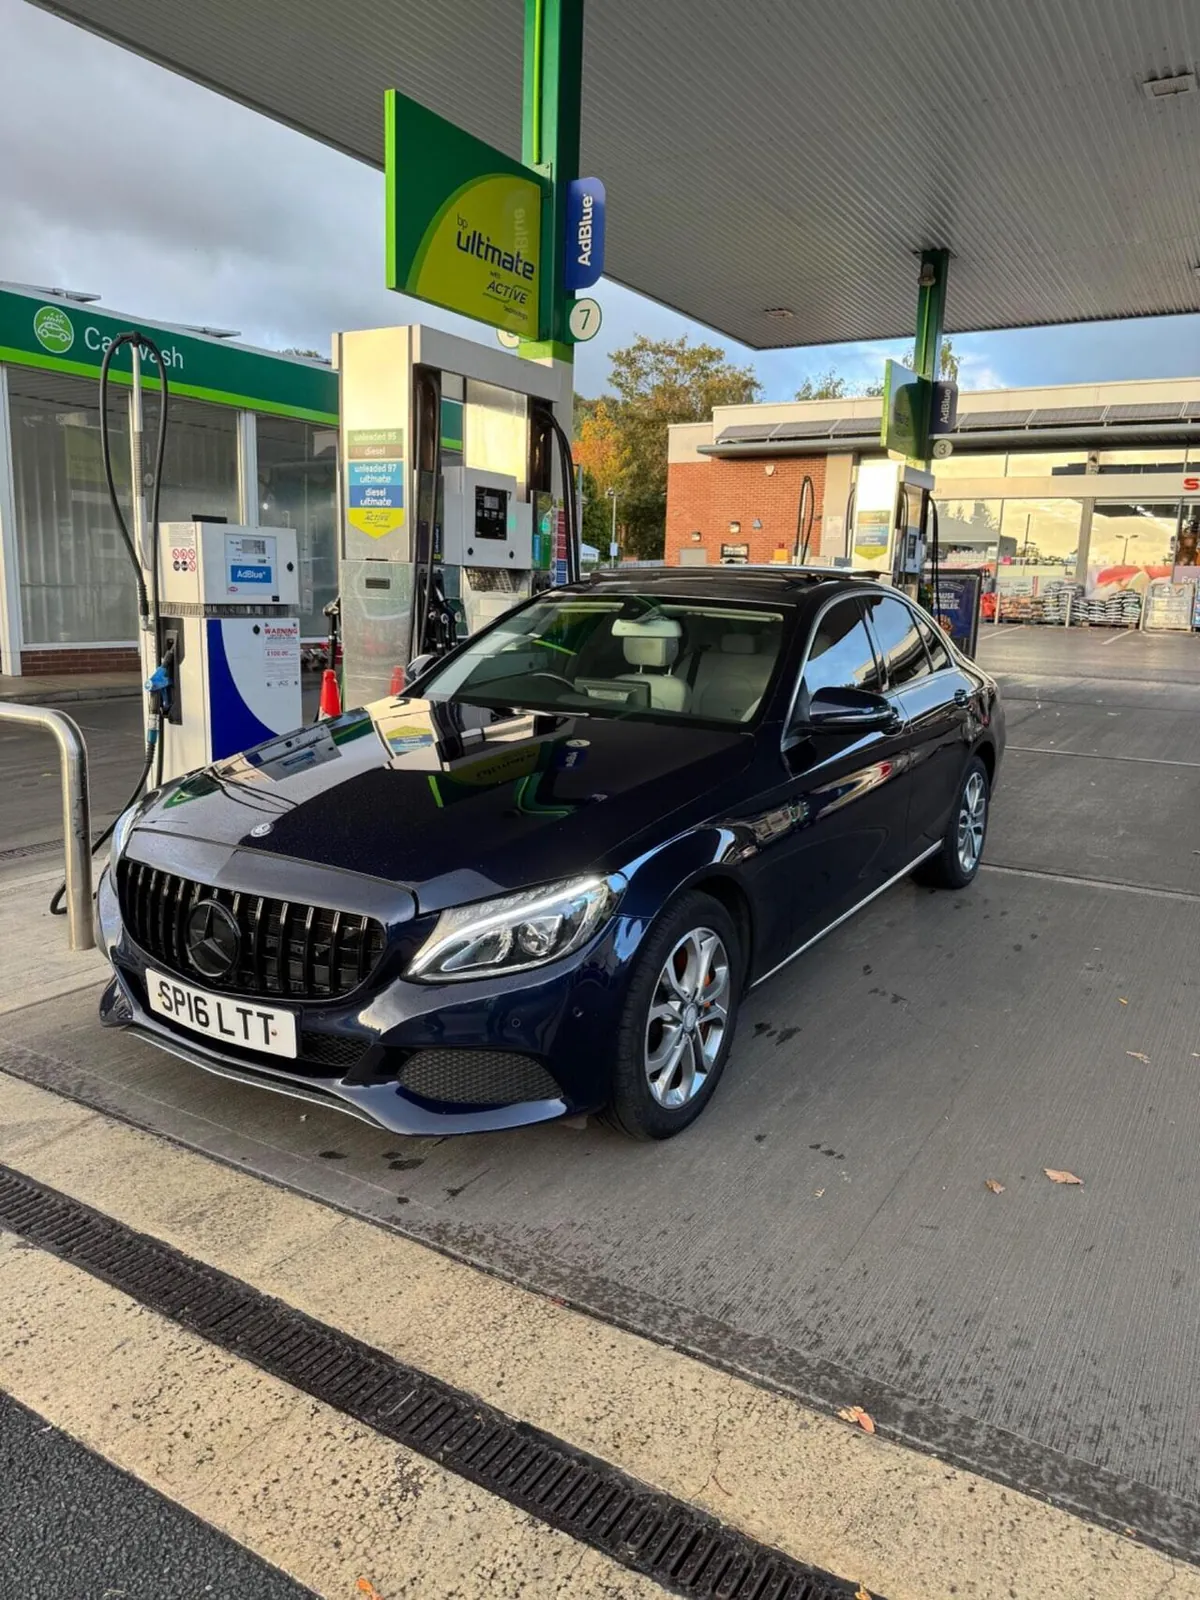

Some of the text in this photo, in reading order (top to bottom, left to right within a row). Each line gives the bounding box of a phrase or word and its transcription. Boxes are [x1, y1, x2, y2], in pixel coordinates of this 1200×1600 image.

[457, 212, 468, 231] bp
[456, 230, 535, 281] ultimate
[487, 280, 528, 304] ACTIVE
[579, 308, 591, 331] 7
[940, 389, 951, 424] AdBlue
[353, 432, 386, 442] unleaded
[364, 446, 386, 456] diesel
[940, 443, 947, 455] 3
[354, 464, 386, 473] unleaded
[359, 474, 392, 484] ultimate
[365, 487, 386, 497] diesel
[360, 497, 392, 507] ultimate
[159, 980, 274, 1045] SP16 LTT
